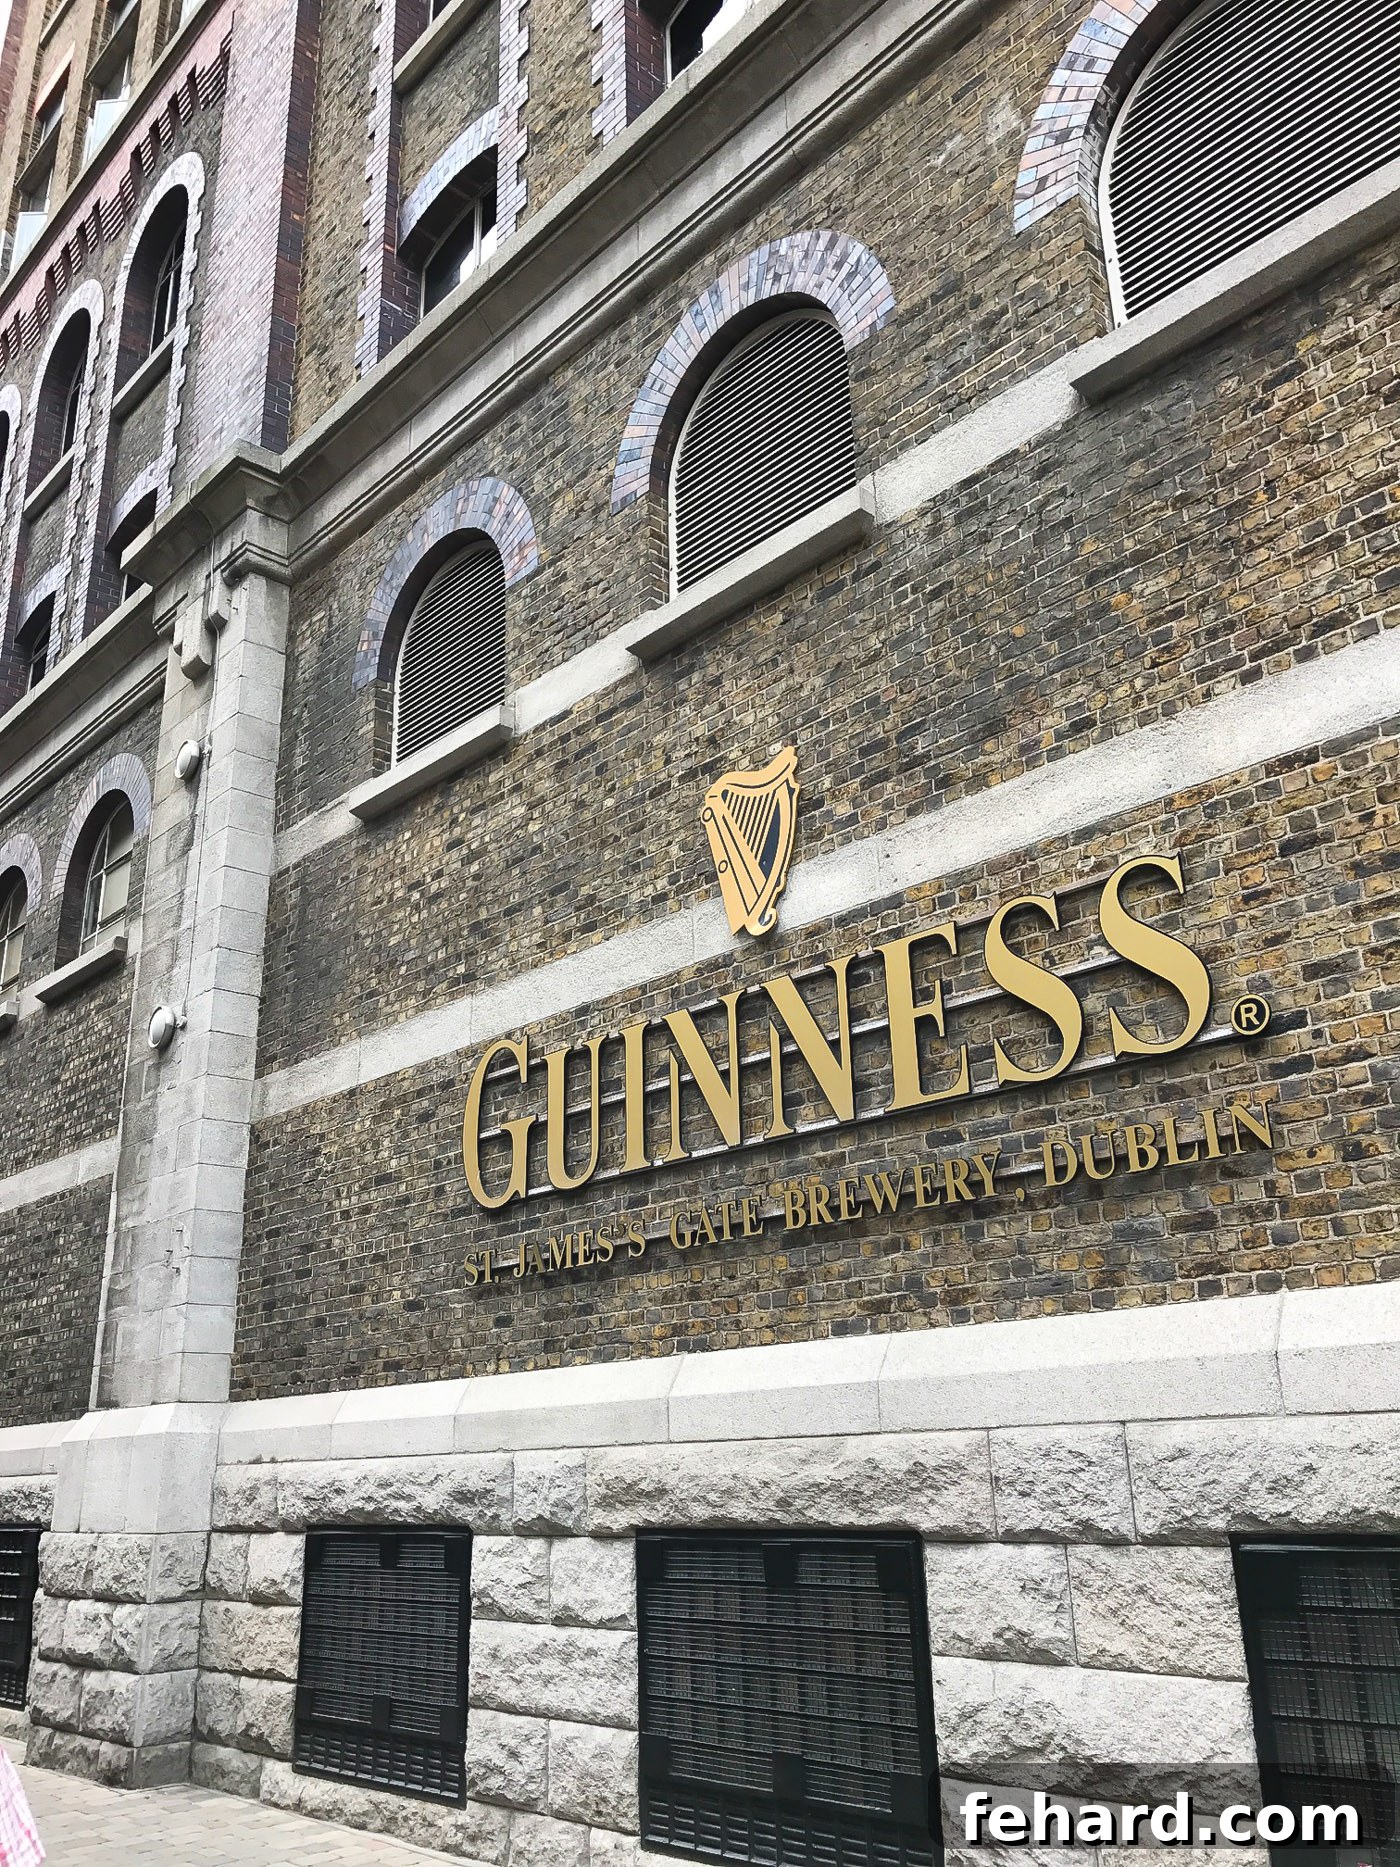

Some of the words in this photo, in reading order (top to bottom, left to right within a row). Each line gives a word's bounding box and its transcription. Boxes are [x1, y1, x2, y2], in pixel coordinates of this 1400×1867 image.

[463, 853, 1211, 1209] GUINNESS
[464, 1250, 499, 1287] ST.
[669, 1195, 763, 1250] GATE
[1041, 1100, 1274, 1187] DUBLIN
